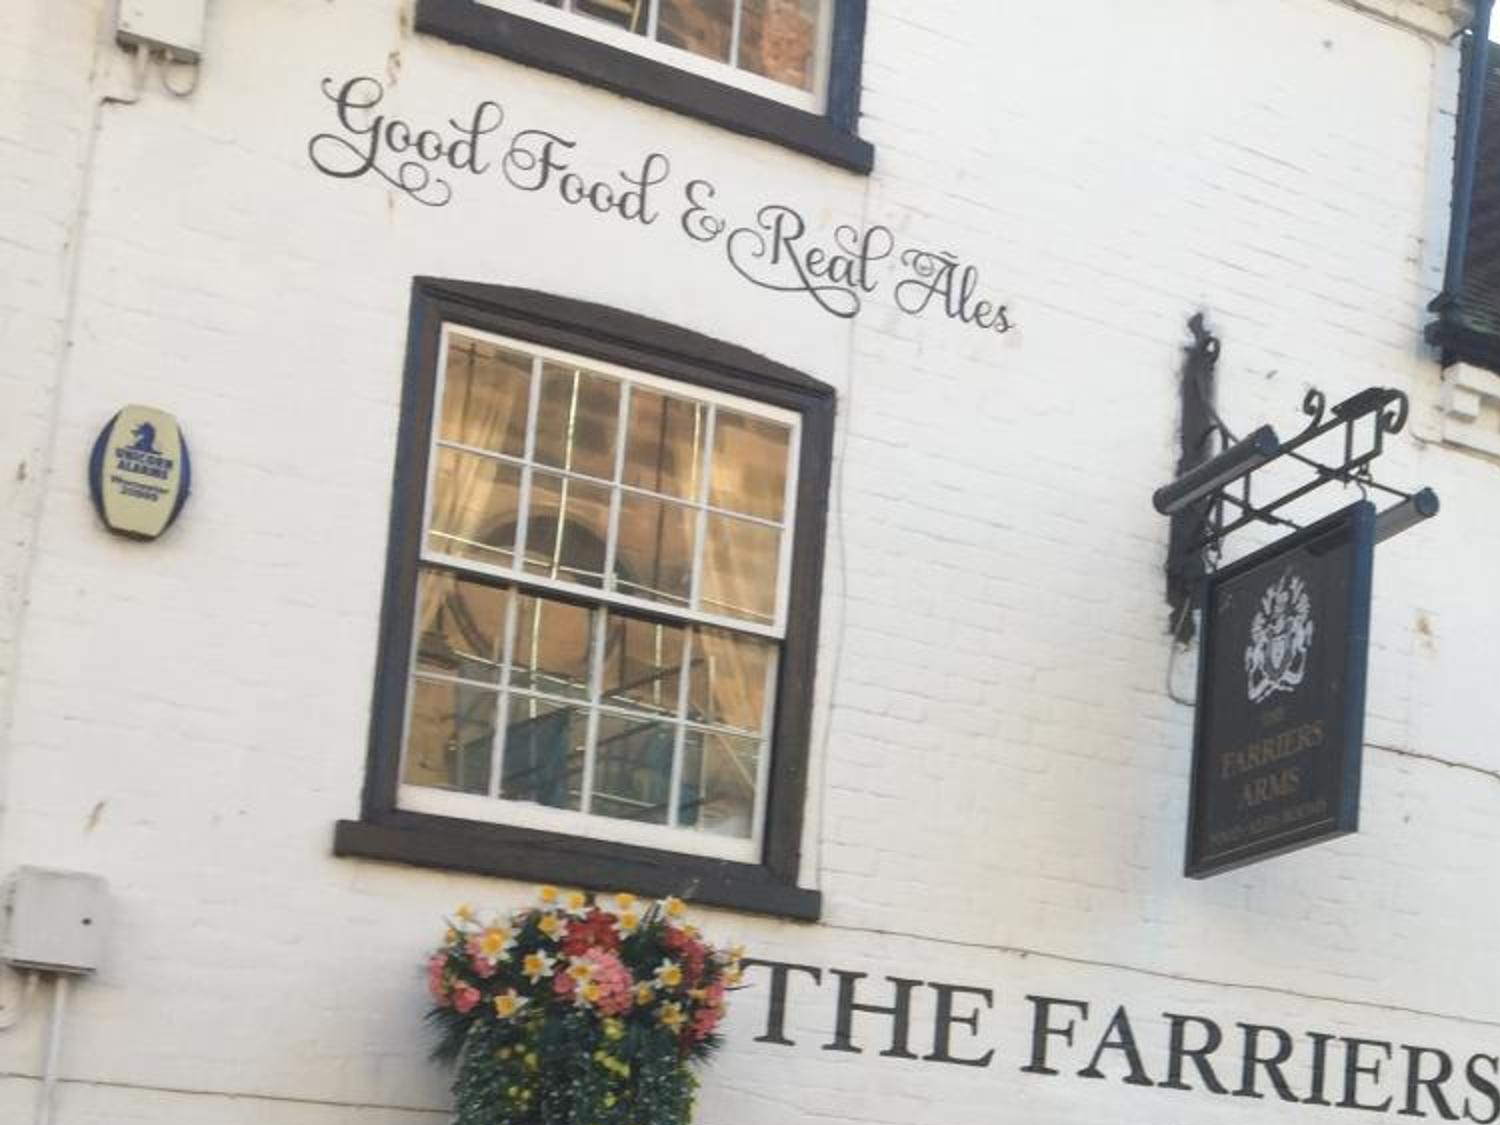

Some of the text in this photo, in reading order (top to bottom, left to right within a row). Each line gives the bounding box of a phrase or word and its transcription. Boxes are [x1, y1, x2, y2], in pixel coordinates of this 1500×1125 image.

[308, 76, 1015, 333] Good Food & Real Ales
[1219, 718, 1327, 780] FARRIERS
[1239, 767, 1301, 809] ARMS
[740, 957, 996, 1068] THE
